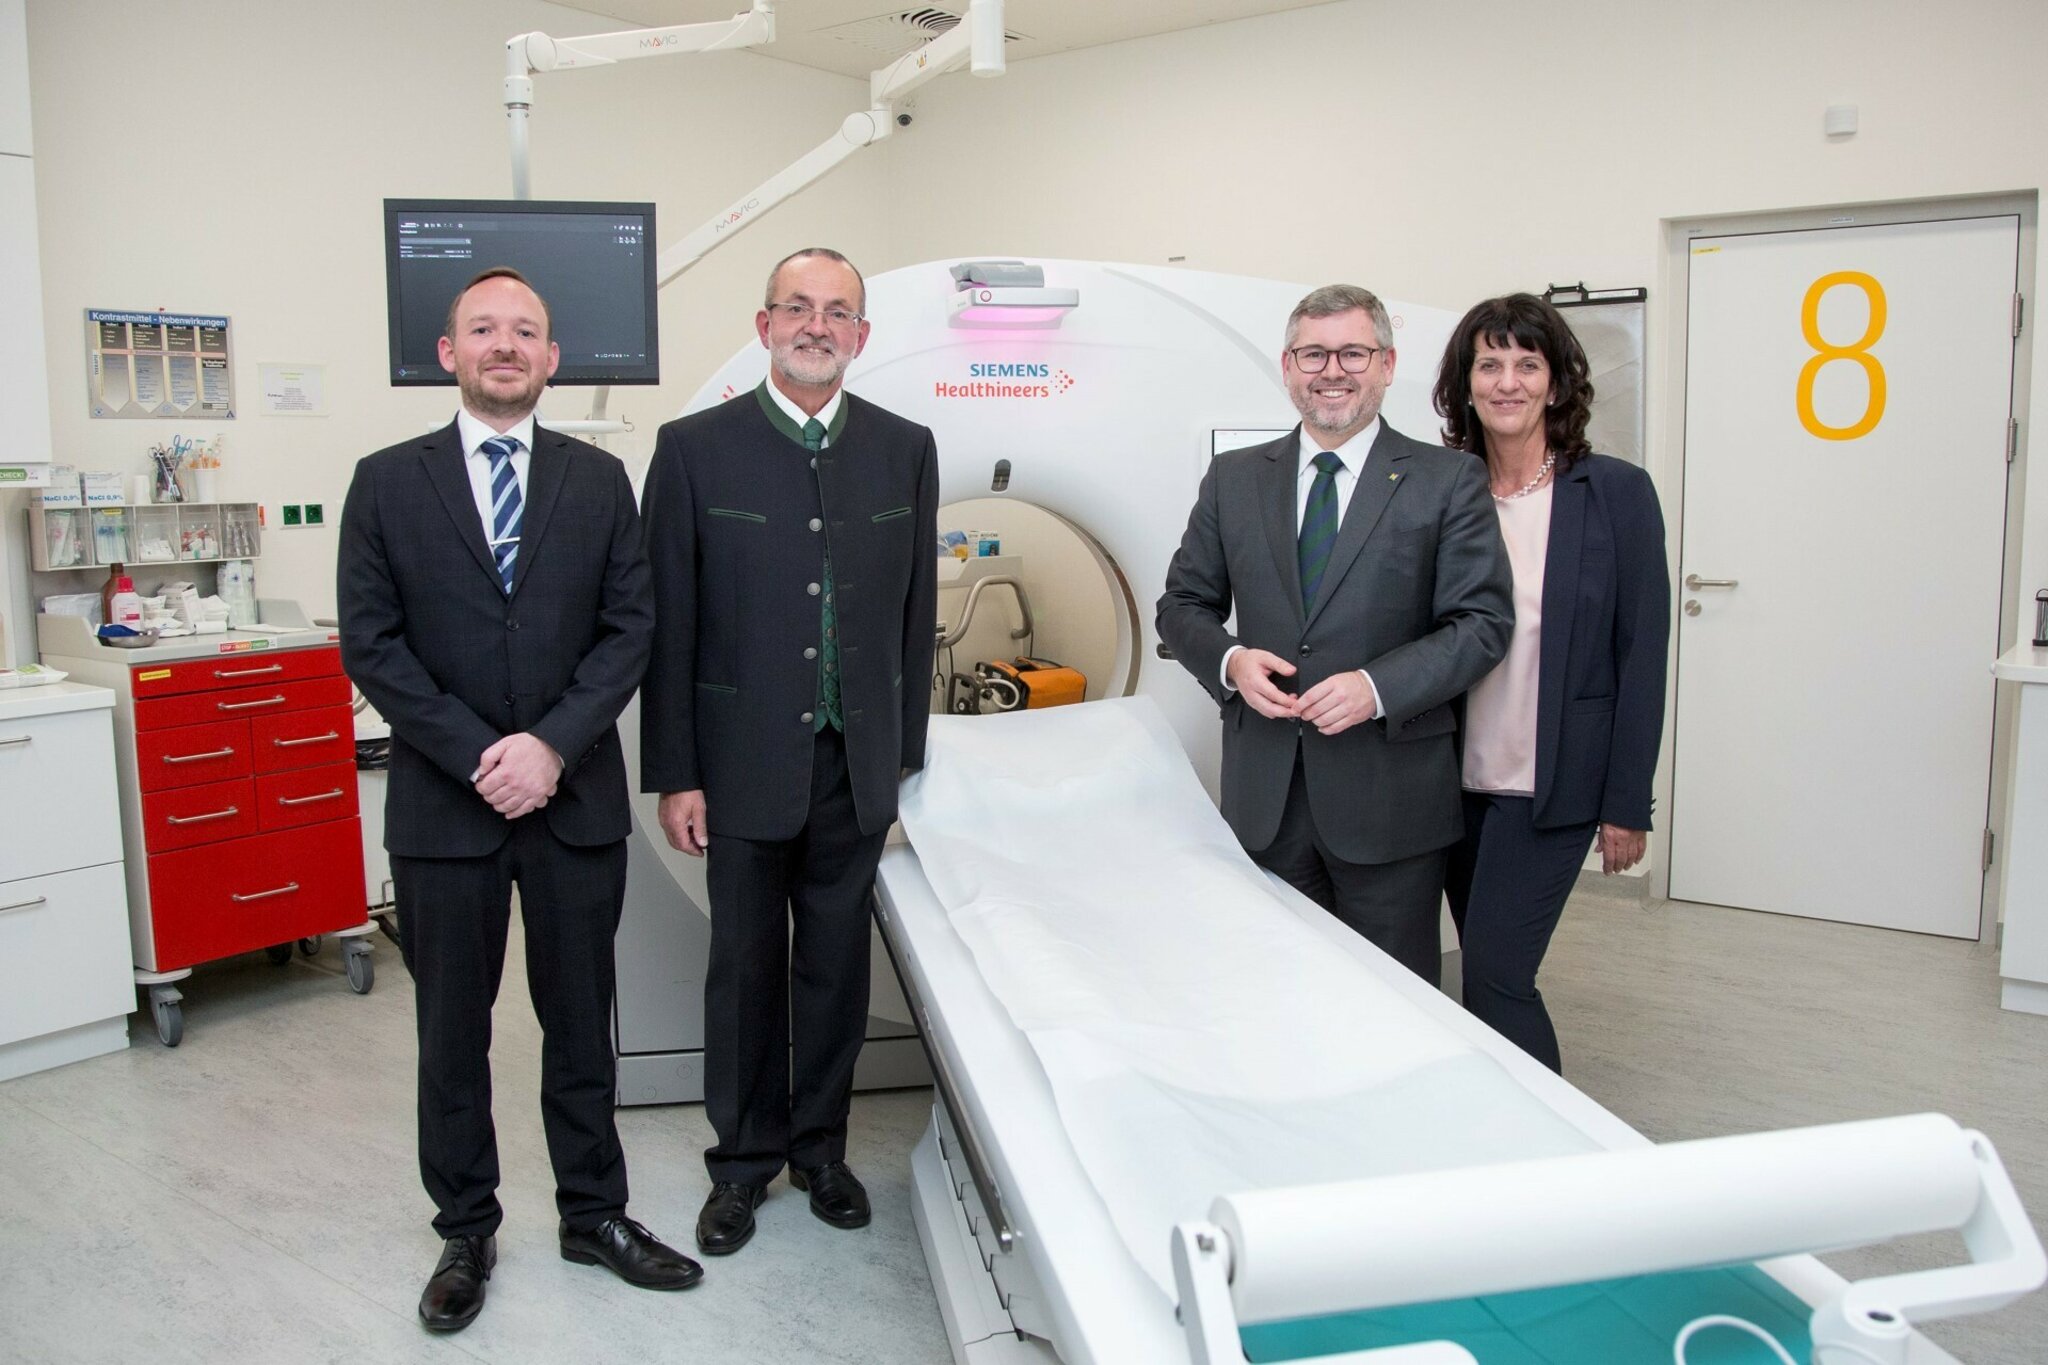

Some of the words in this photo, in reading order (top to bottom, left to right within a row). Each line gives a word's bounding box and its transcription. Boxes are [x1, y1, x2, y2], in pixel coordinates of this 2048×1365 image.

[640, 34, 678, 48] MAVIG
[716, 198, 760, 232] MAVIG
[92, 311, 152, 323] Kontrastmittel
[159, 315, 226, 328] Nebenwirkungen
[1796, 271, 1887, 441] 8
[970, 363, 1049, 377] SIEMENS
[935, 381, 1049, 398] Healthineers
